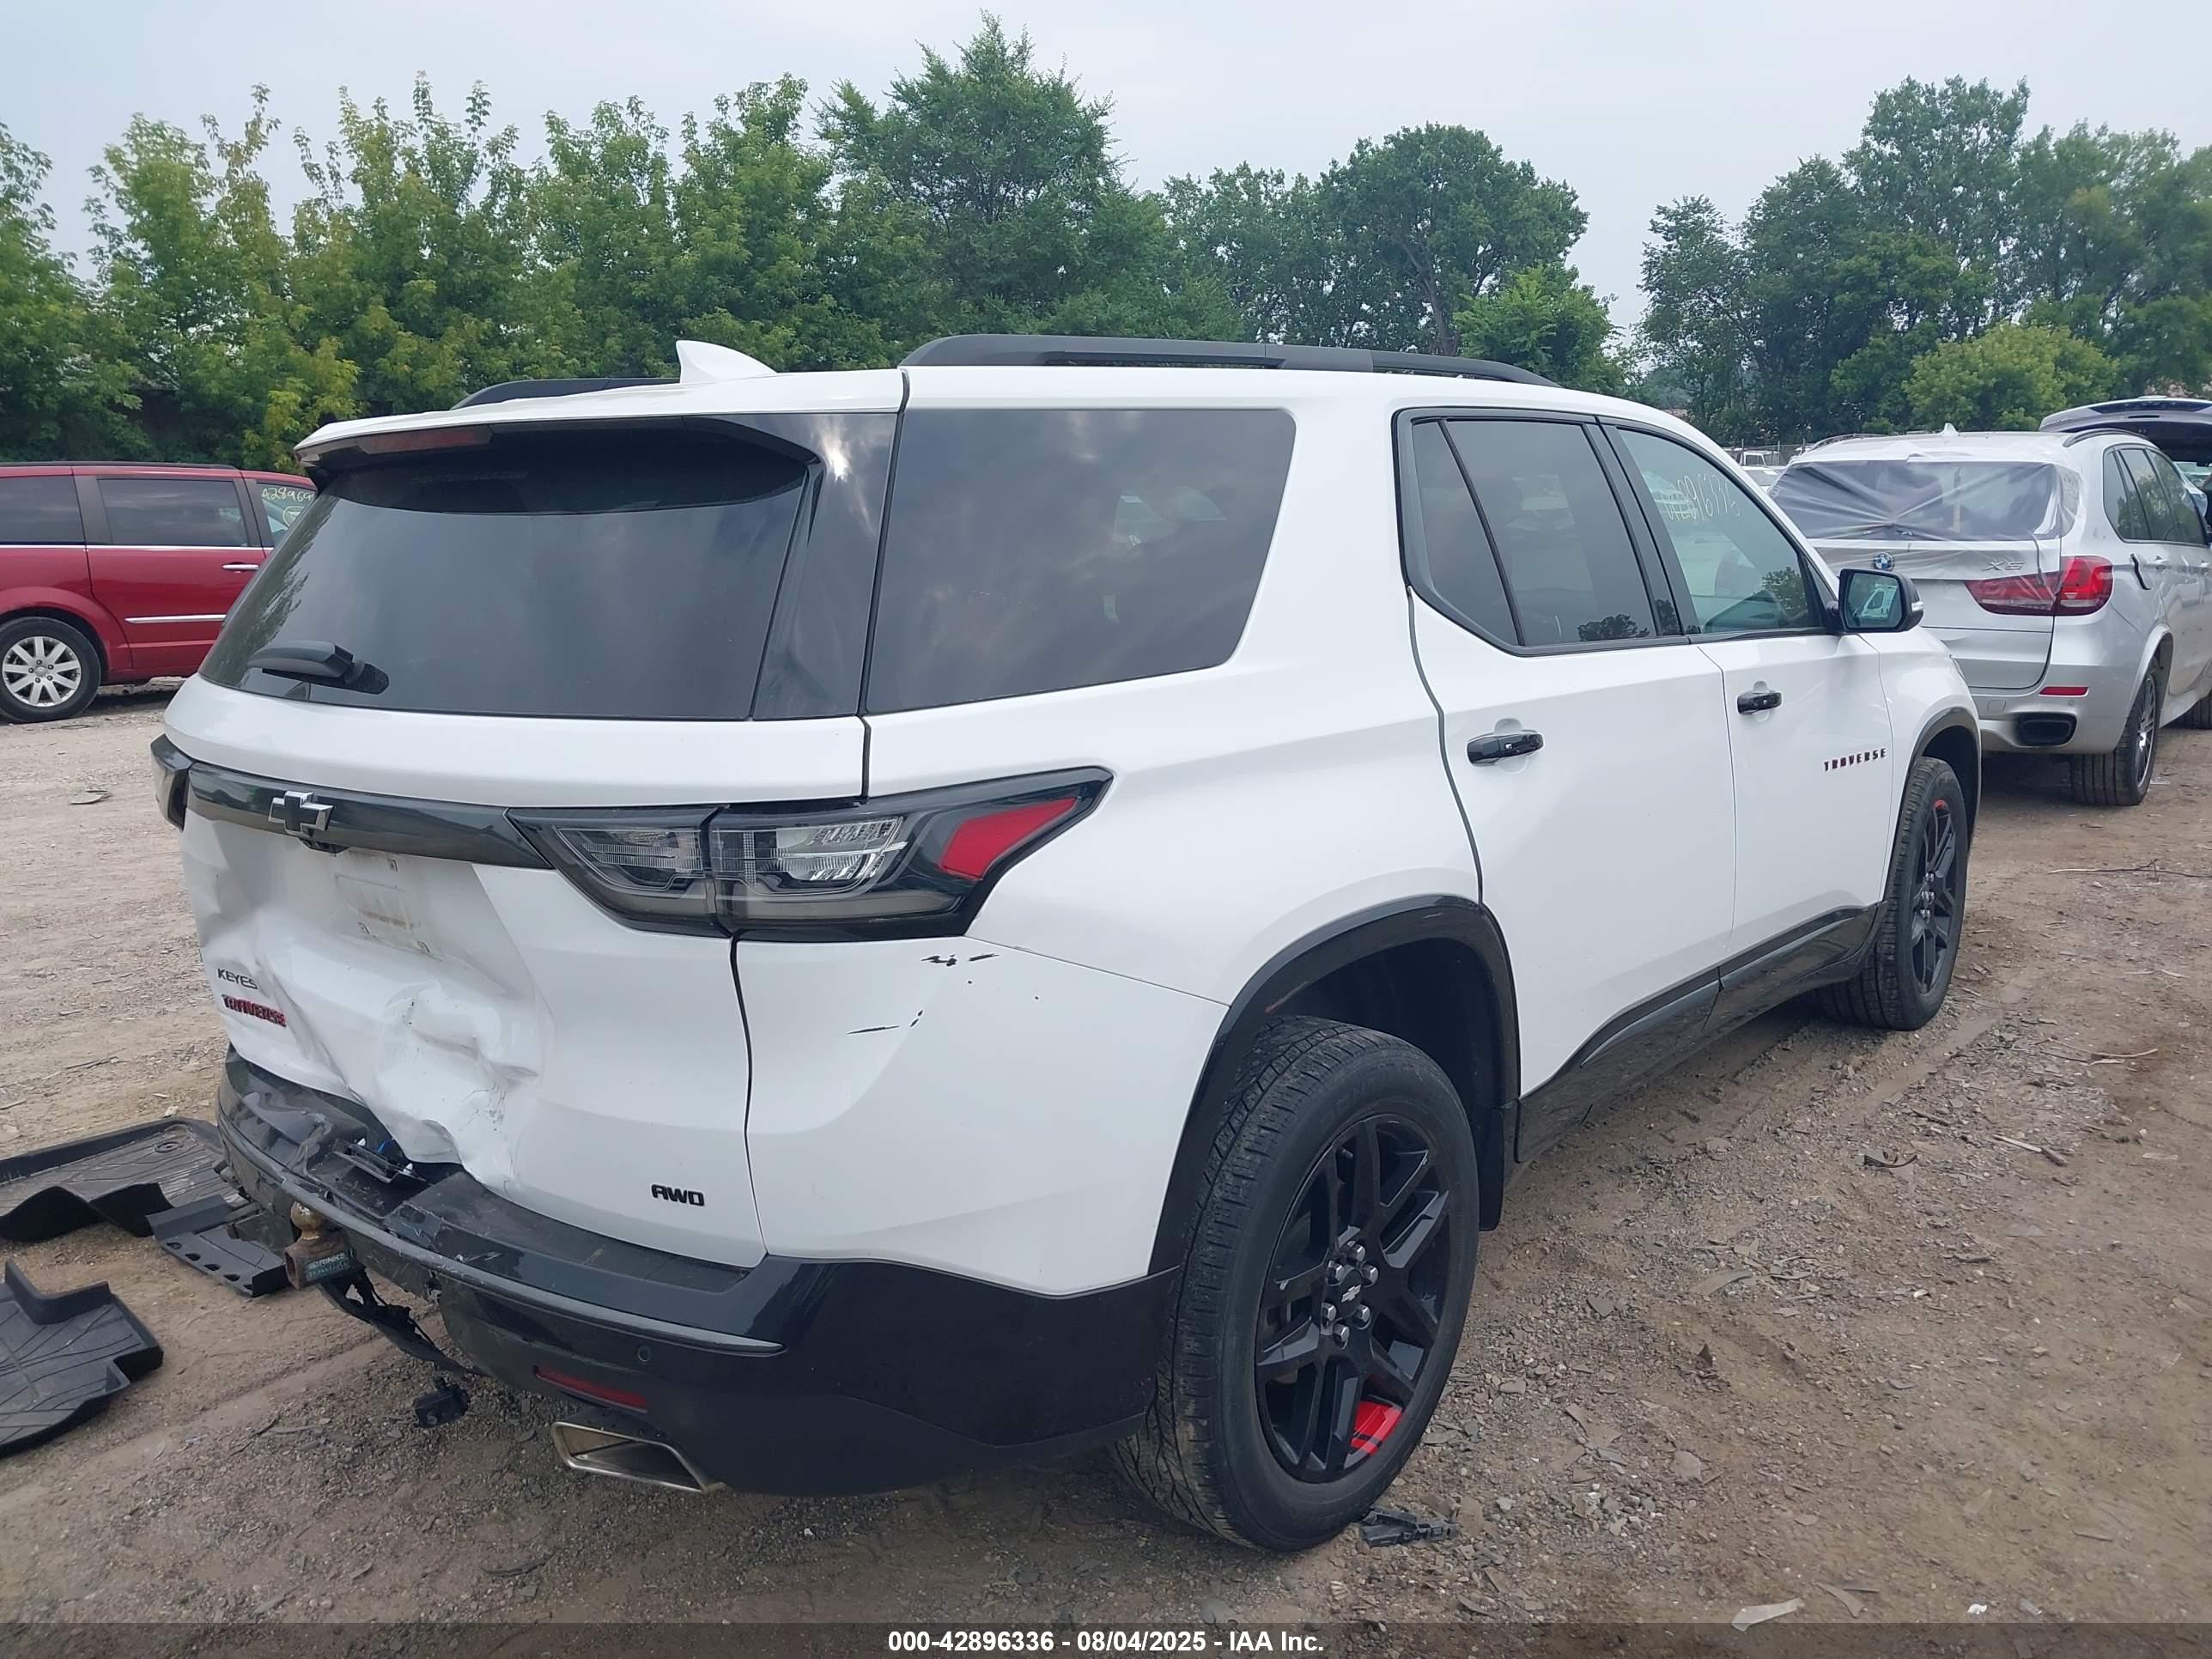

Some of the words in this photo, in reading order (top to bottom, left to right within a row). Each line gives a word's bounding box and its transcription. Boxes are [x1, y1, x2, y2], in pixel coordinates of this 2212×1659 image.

[261, 487, 314, 501] 428969
[1981, 561, 2024, 571] X5
[1824, 748, 1886, 772] TRAVERSE
[217, 969, 258, 990] KEYES
[651, 1184, 705, 1206] AWD
